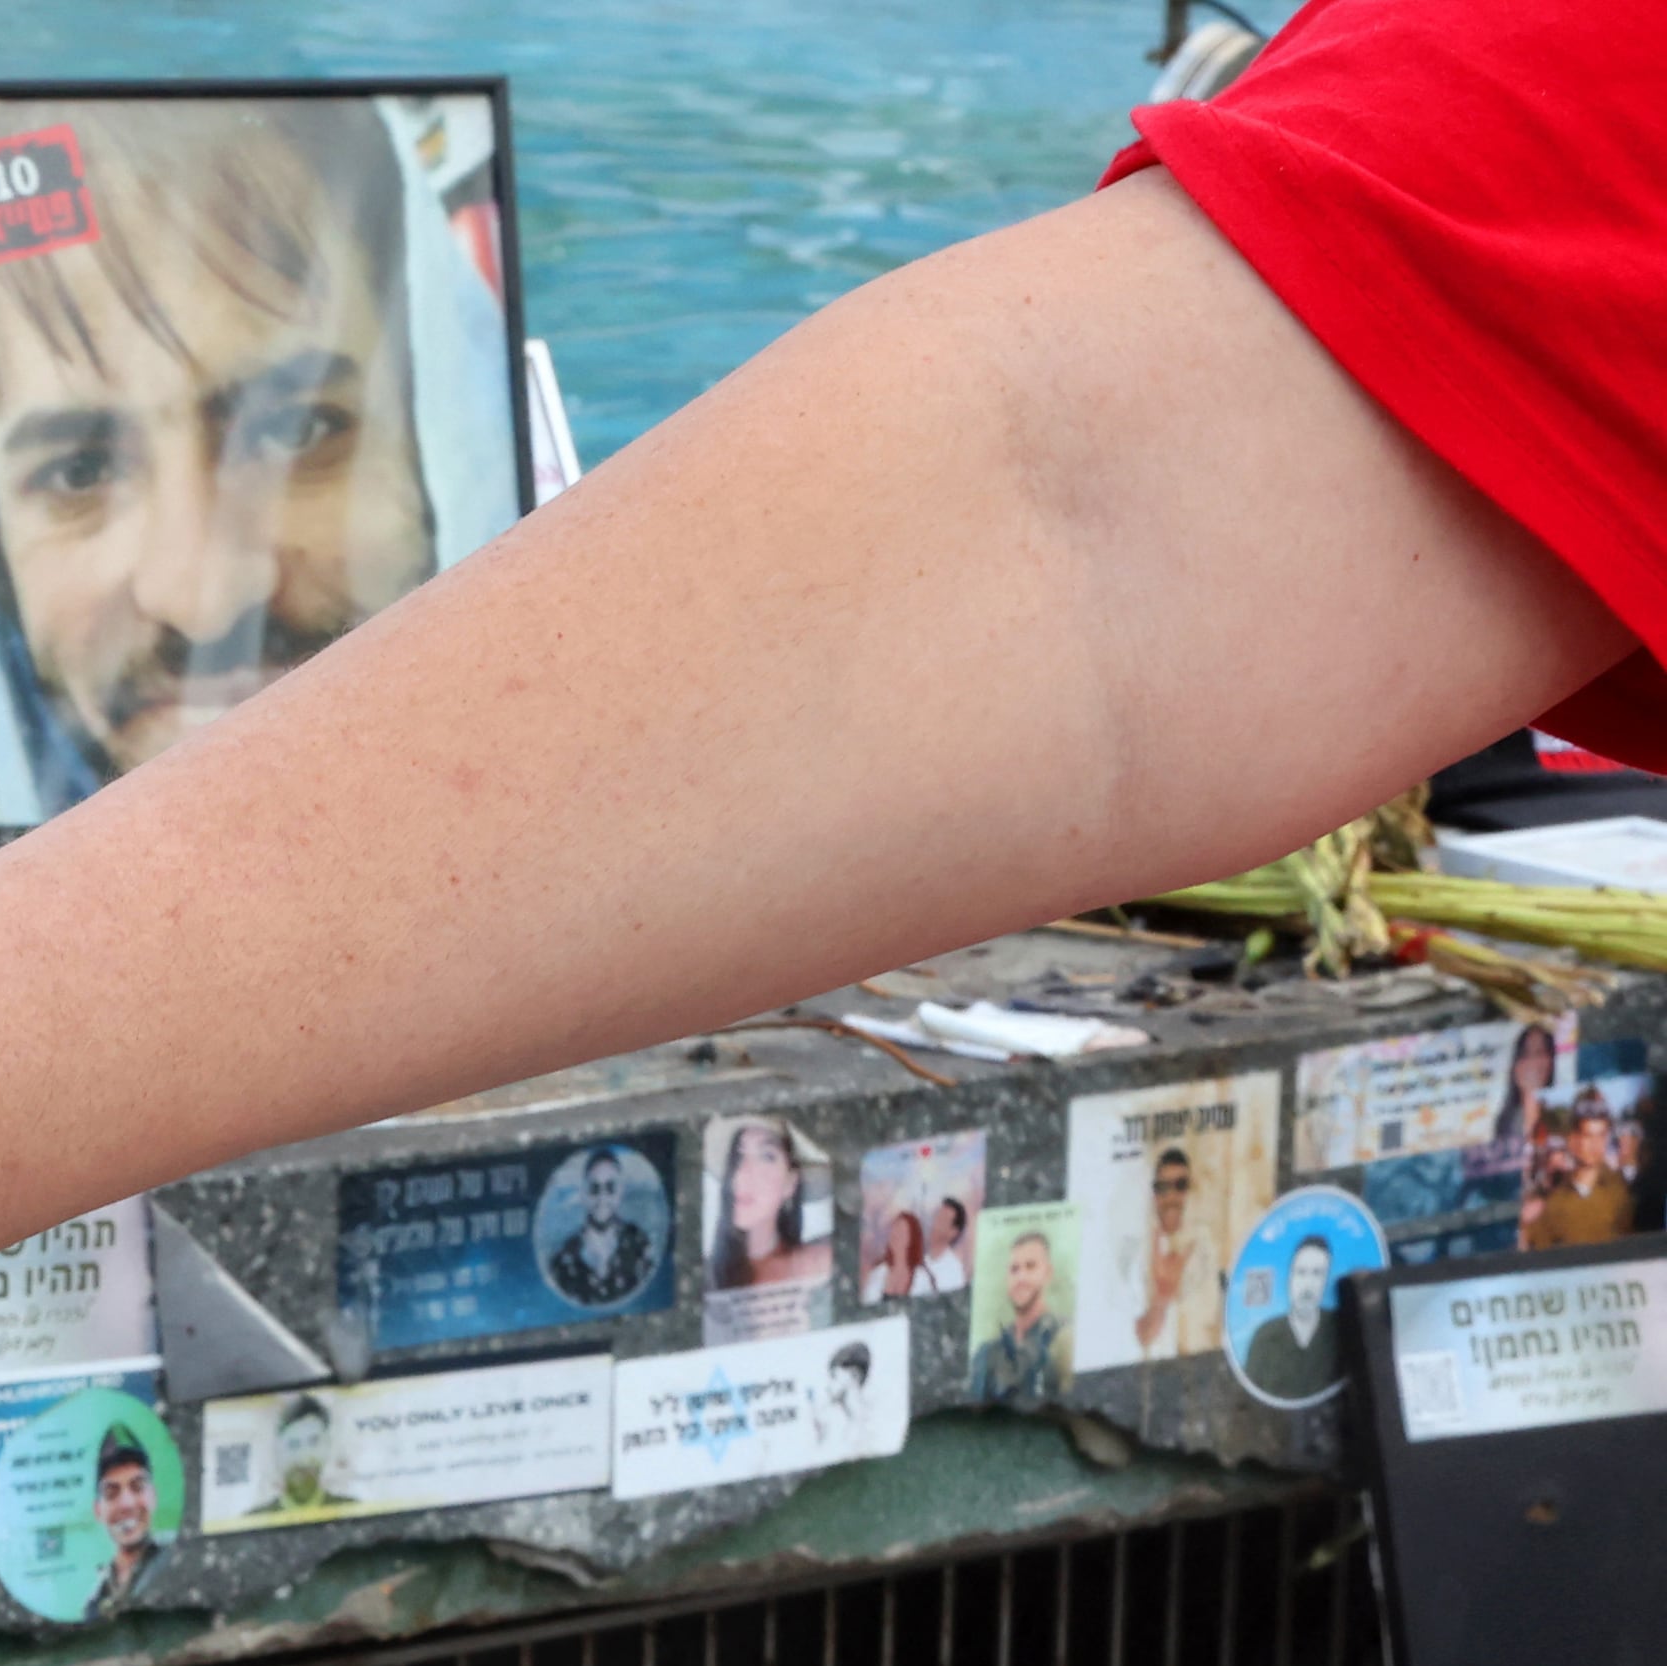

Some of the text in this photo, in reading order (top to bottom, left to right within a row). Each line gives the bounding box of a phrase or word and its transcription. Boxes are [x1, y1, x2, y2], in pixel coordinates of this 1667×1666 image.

[25, 1261, 101, 1297] תהיו
[1450, 1280, 1647, 1328] תהיו שמחים
[1469, 1318, 1641, 1370] תהיו נחמן!
[356, 1415, 402, 1433] YOU
[407, 1406, 463, 1428] ONLY
[469, 1398, 526, 1419] LIVE
